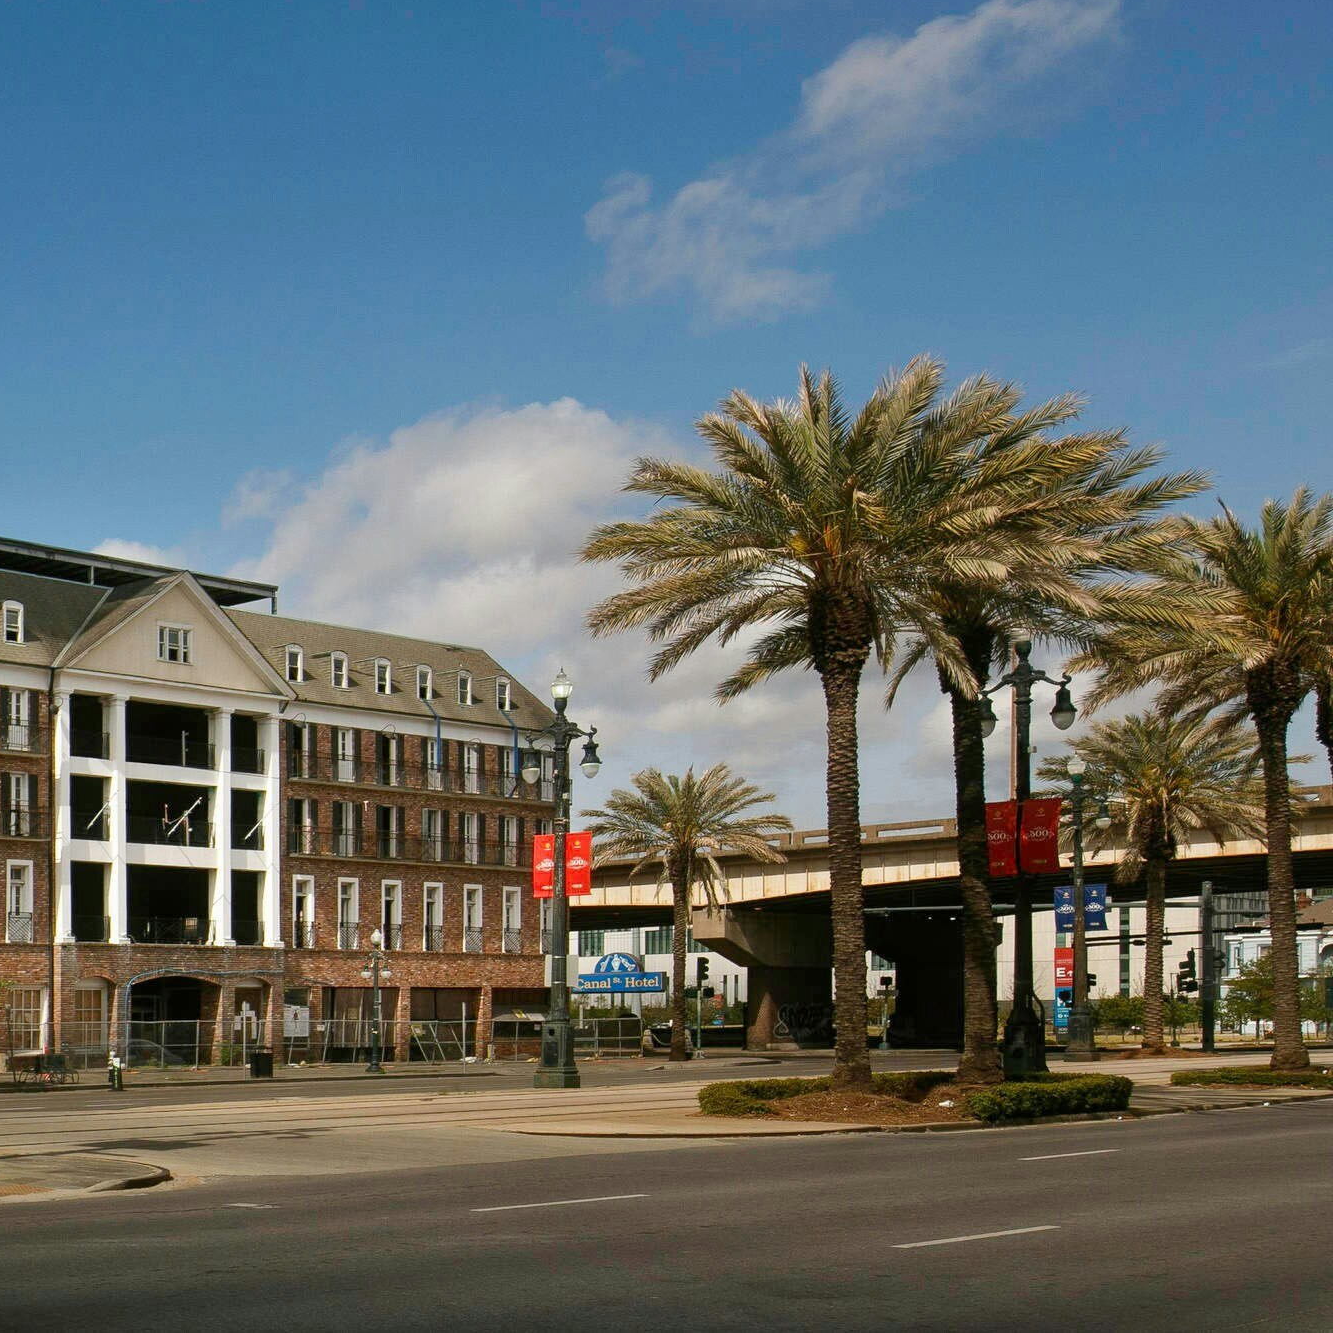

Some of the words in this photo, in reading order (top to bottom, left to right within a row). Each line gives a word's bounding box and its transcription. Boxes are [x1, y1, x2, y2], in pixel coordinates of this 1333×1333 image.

[1056, 967, 1066, 977] E
[578, 977, 611, 989] Canal
[625, 976, 659, 988] Hotel
